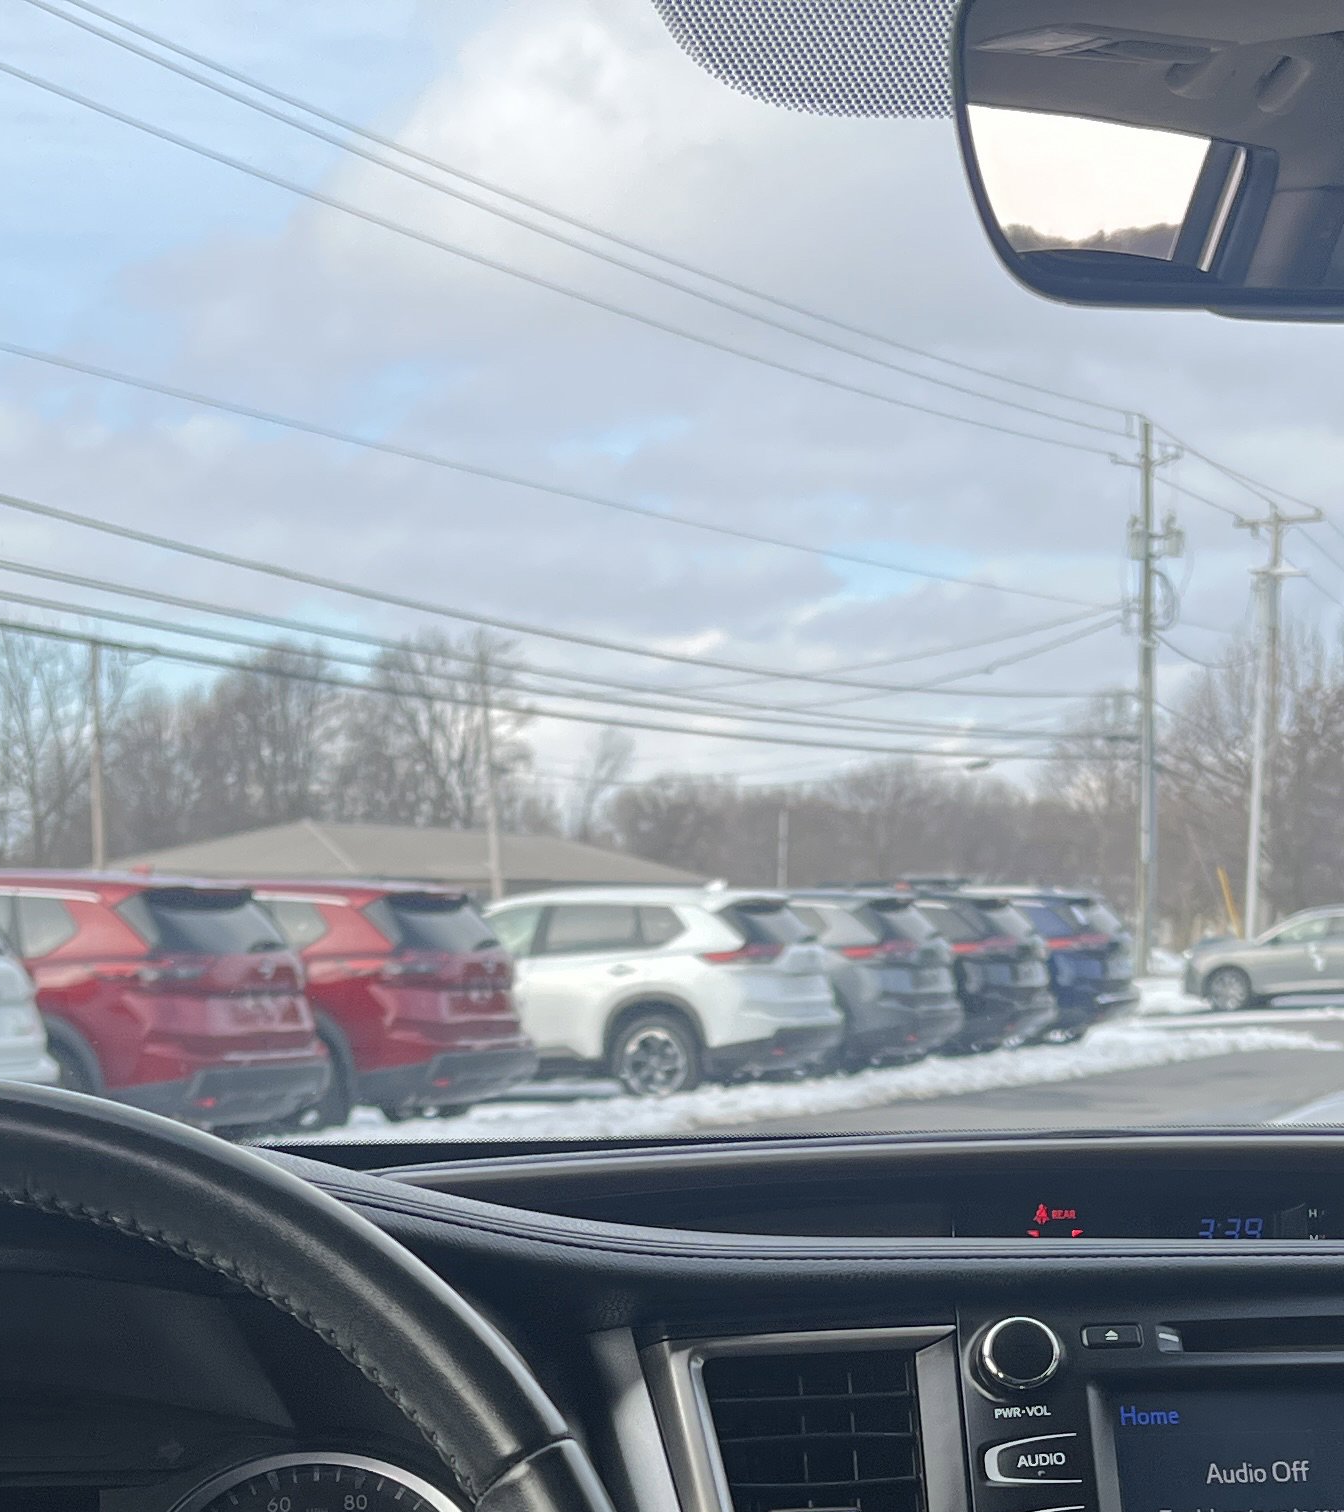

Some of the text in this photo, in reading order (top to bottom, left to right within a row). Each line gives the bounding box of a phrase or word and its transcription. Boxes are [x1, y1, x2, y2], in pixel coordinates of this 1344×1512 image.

[1119, 1406, 1181, 1426] Home
[1017, 1452, 1067, 1468] AUDIO
[1206, 1460, 1311, 1485] Audio Off
[343, 1495, 368, 1512] 80
